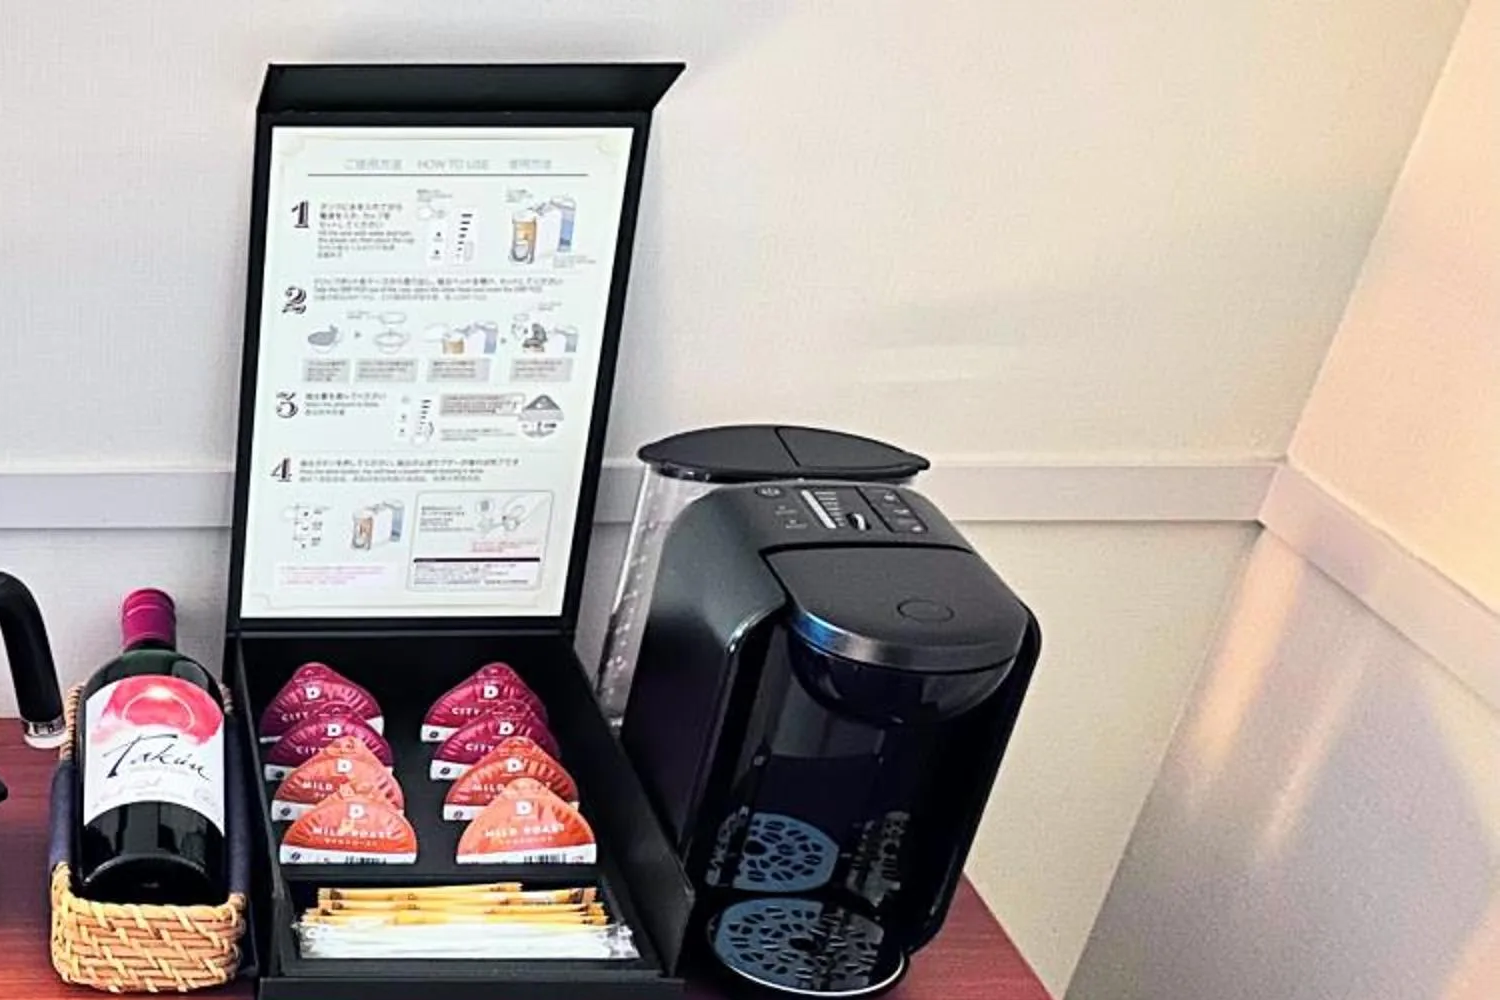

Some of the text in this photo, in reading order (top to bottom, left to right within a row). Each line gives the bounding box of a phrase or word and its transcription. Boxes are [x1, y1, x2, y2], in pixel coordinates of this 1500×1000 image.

[417, 159, 445, 170] HOW
[291, 200, 309, 229] 1
[282, 286, 307, 315] 2
[276, 391, 298, 419] 3
[270, 457, 292, 483] 4
[281, 711, 309, 723] CITY
[451, 707, 479, 716] CITY
[302, 781, 334, 790] MILD
[312, 826, 394, 840] MILD ROAST
[485, 823, 565, 838] MILD ROAST
